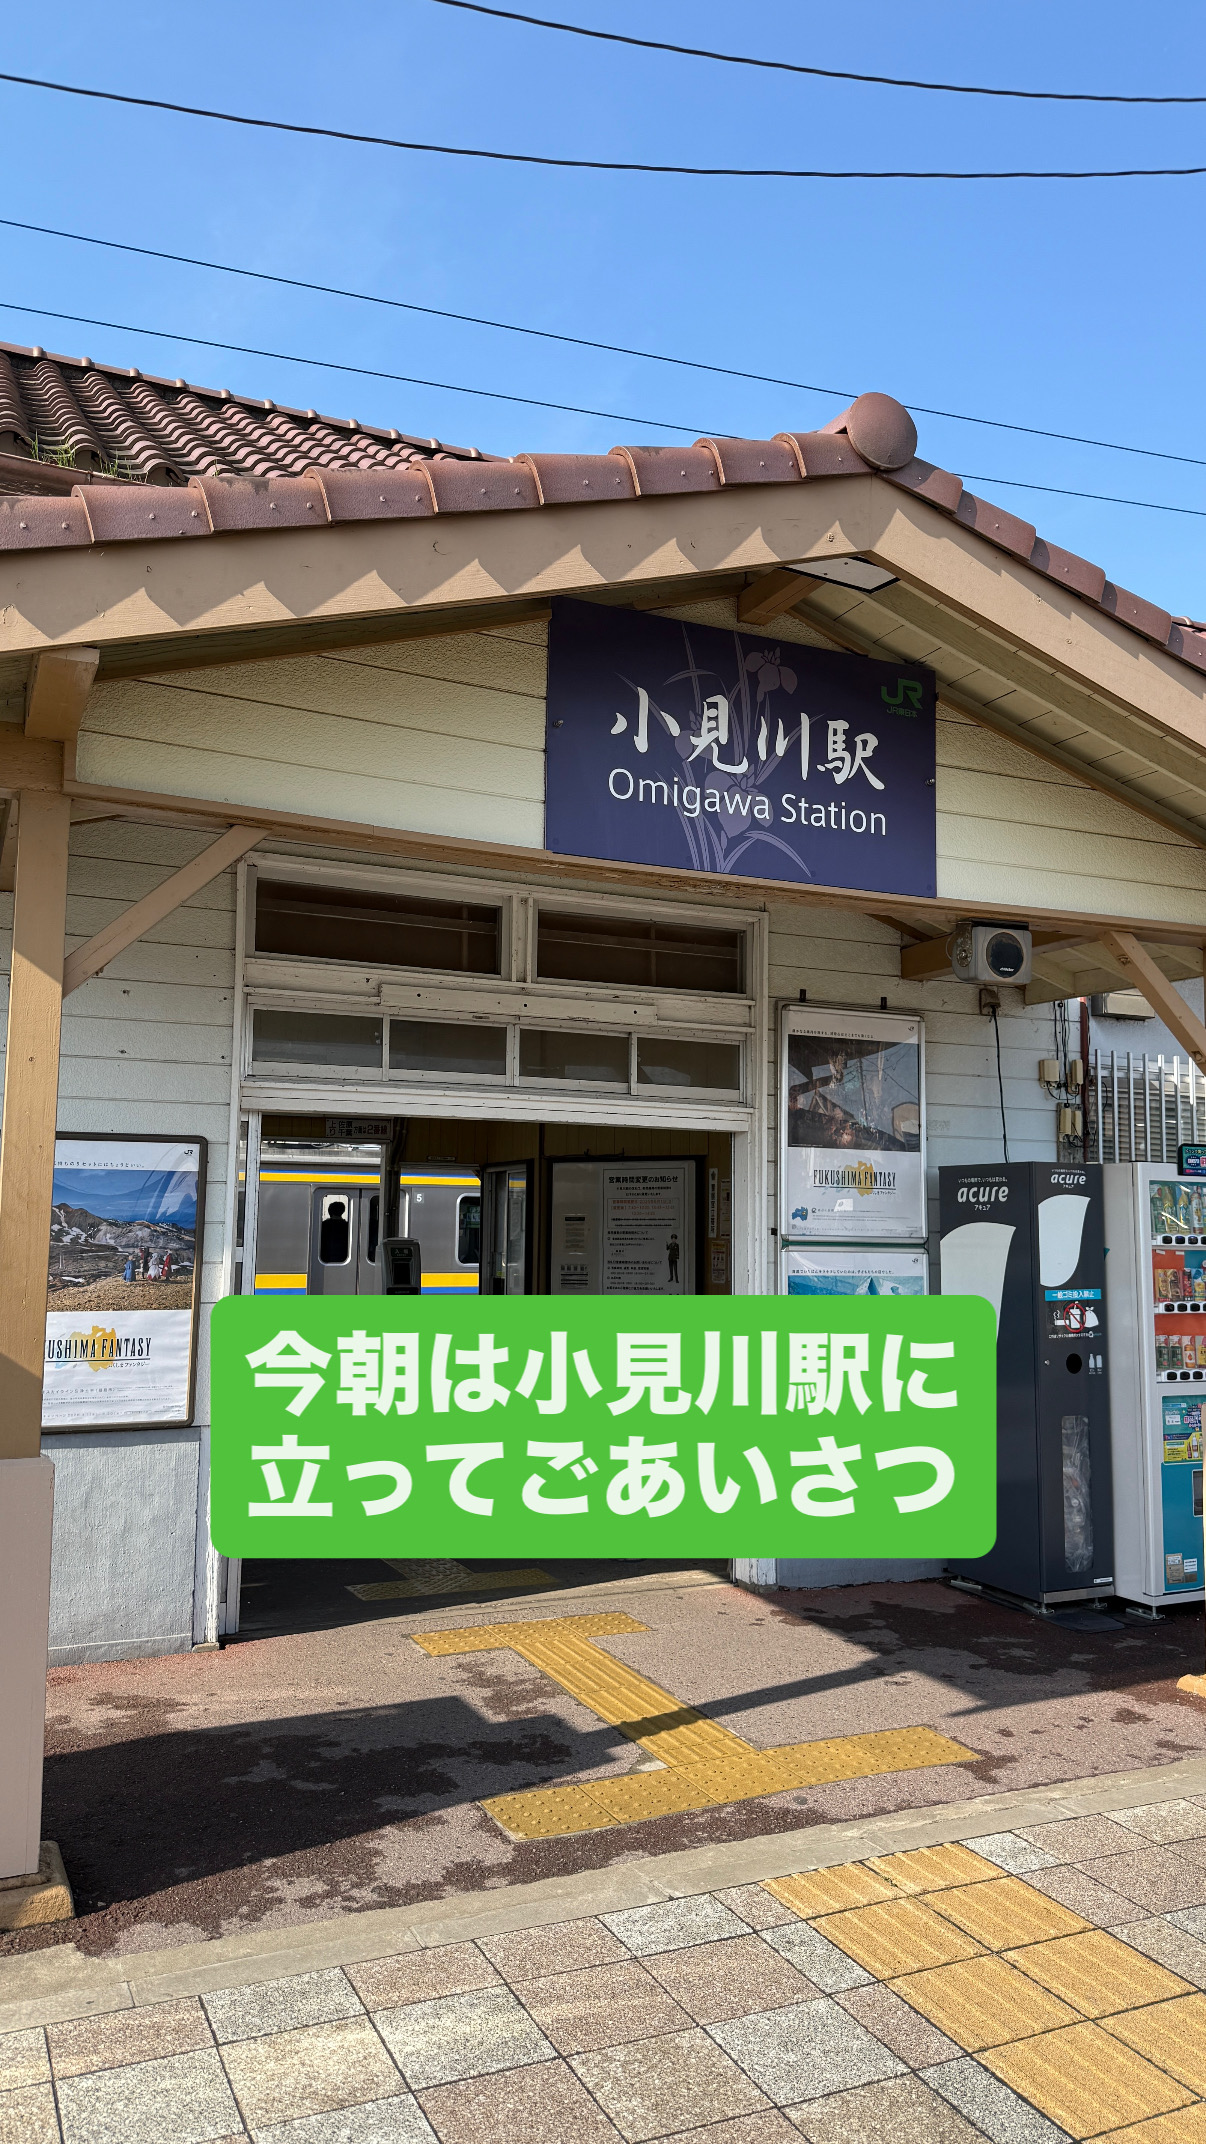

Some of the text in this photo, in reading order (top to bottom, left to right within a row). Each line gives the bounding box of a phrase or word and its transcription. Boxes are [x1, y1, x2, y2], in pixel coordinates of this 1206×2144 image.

[881, 678, 923, 709] JR
[610, 686, 885, 790] 小見川駅
[608, 767, 887, 836] Omigawa Station
[608, 1175, 679, 1184] 営業時間変更のお知らせ
[813, 1169, 896, 1187] FUKUSHIMA FANTASY
[1050, 1174, 1087, 1185] acure
[416, 1193, 423, 1203] 5
[957, 1186, 1009, 1202] acure
[1051, 1290, 1095, 1299] 一般ゴミ投入禁止
[101, 1337, 152, 1358] FANTASY
